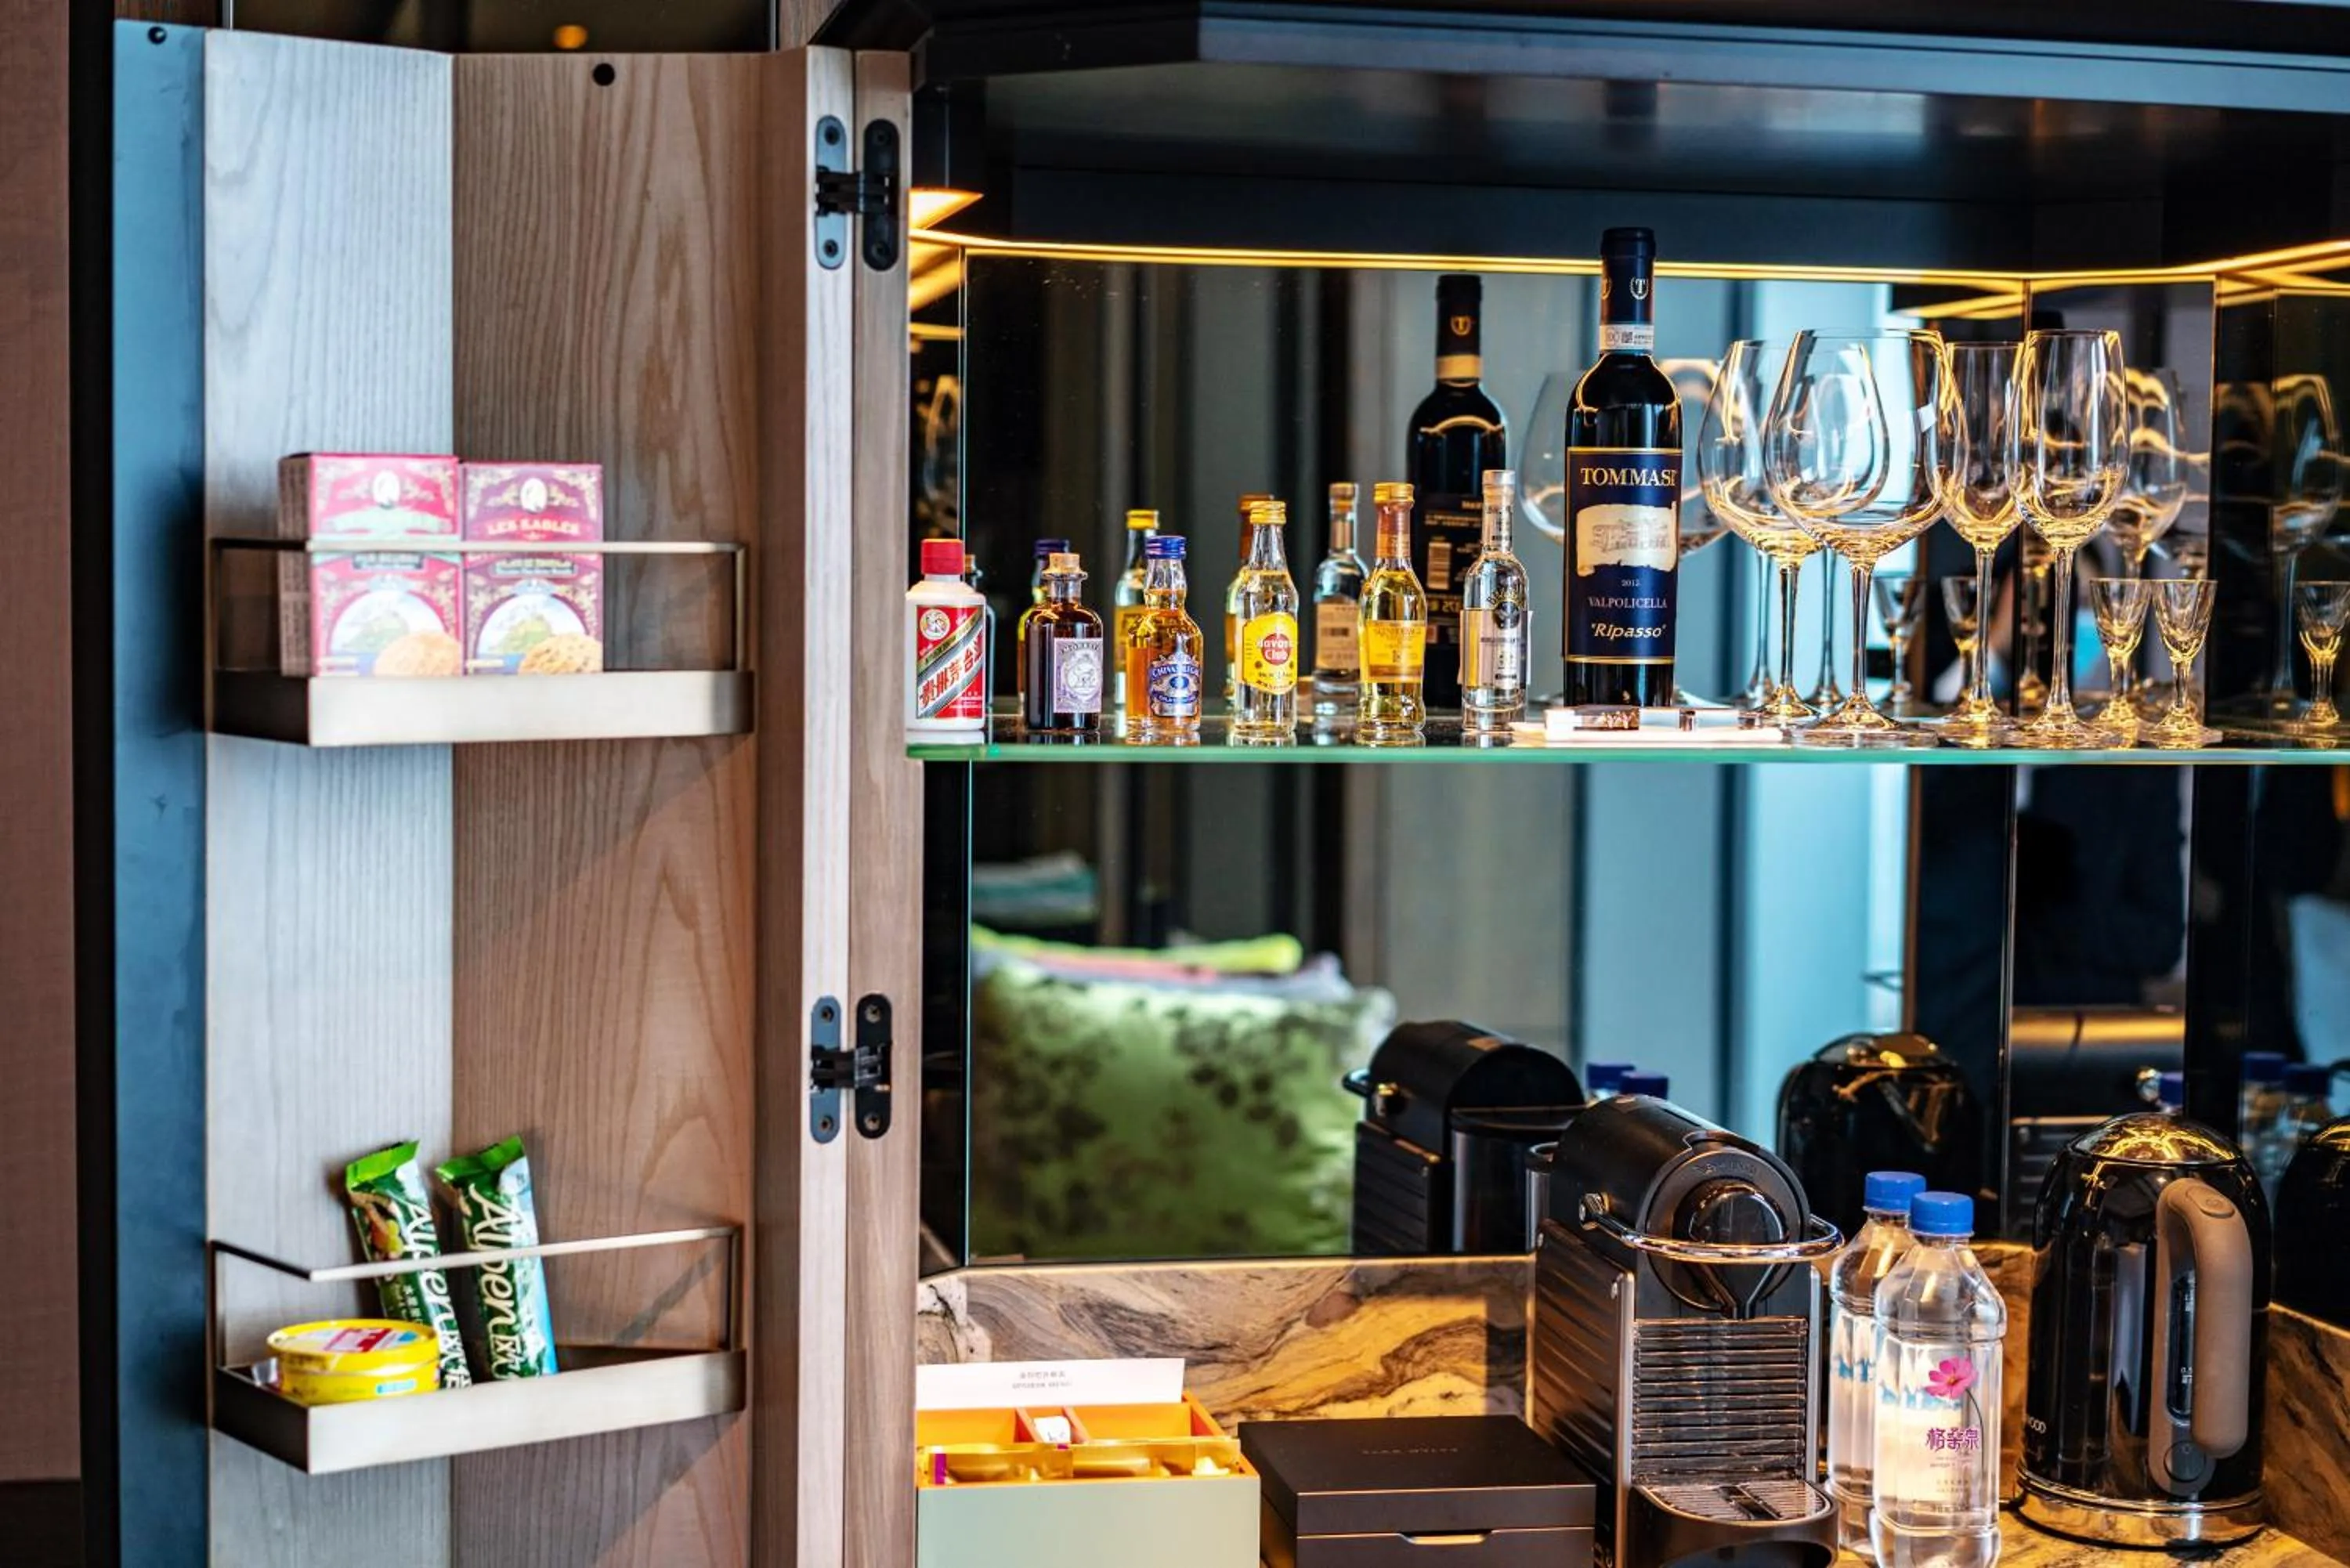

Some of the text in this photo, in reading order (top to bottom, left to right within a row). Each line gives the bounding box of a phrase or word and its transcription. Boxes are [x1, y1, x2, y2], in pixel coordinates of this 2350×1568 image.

[1581, 468, 1677, 486] TOMMASI
[1588, 598, 1667, 609] VALPOLICELLA
[1925, 1427, 1979, 1452] 格桑泉
